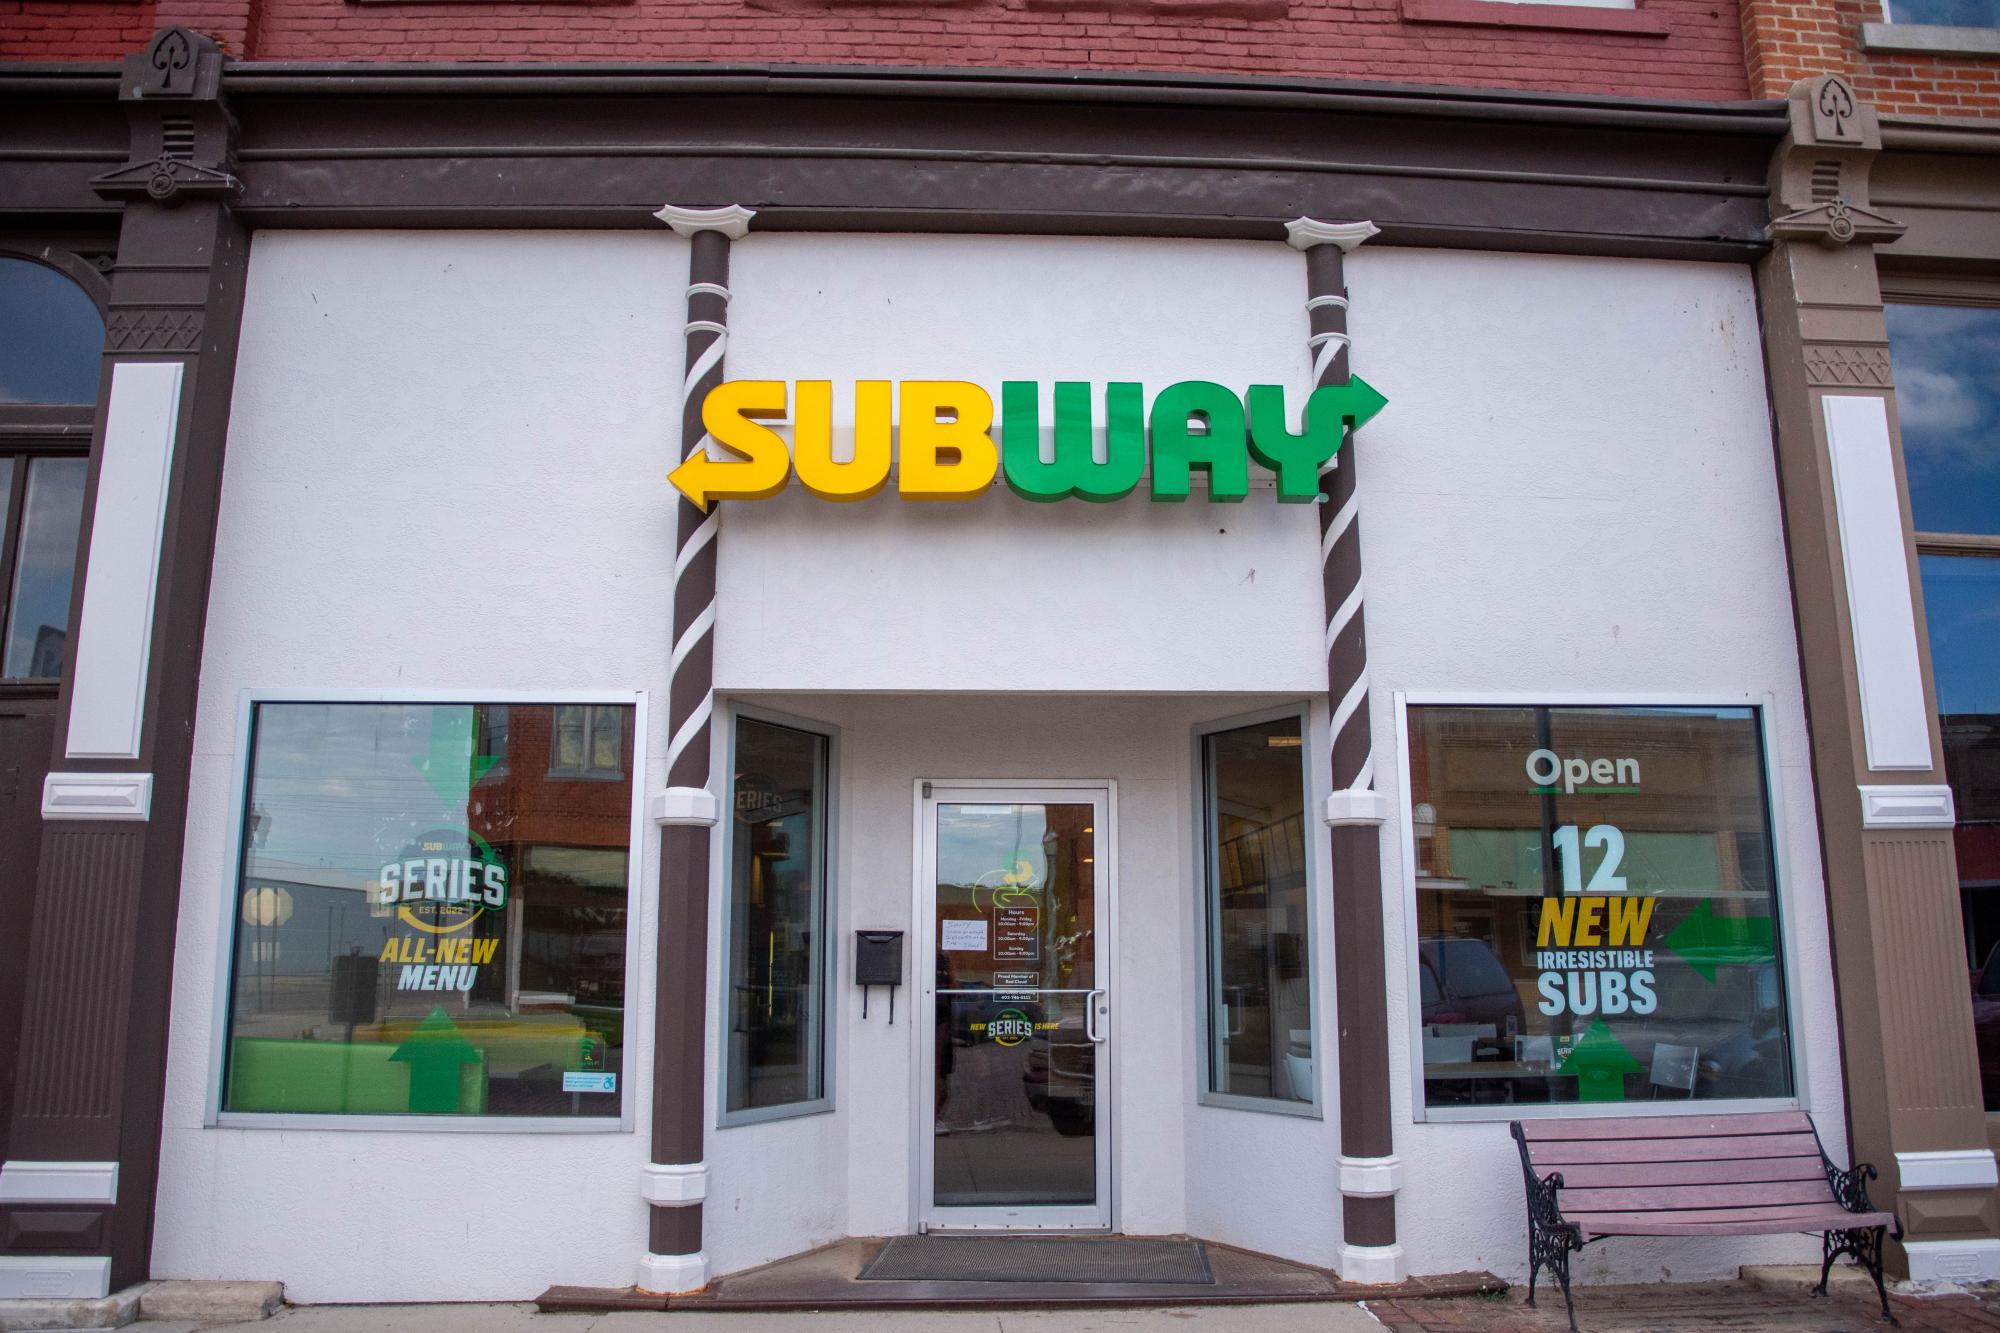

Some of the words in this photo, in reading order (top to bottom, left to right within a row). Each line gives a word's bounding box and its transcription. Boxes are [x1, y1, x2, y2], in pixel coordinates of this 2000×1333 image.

[667, 374, 1389, 514] SUBWAY
[1525, 748, 1641, 794] Open
[735, 790, 784, 814] ERIES
[1553, 824, 1628, 891] 12
[381, 858, 505, 906] SERIES
[1536, 897, 1656, 947] NEW
[379, 937, 499, 964] ALL-NEW
[1537, 950, 1654, 969] IRRESISTIBLE
[398, 965, 478, 991] MENU
[1538, 970, 1658, 1016] SUBS
[970, 1023, 987, 1031] NEW
[988, 1020, 1032, 1037] SERIES
